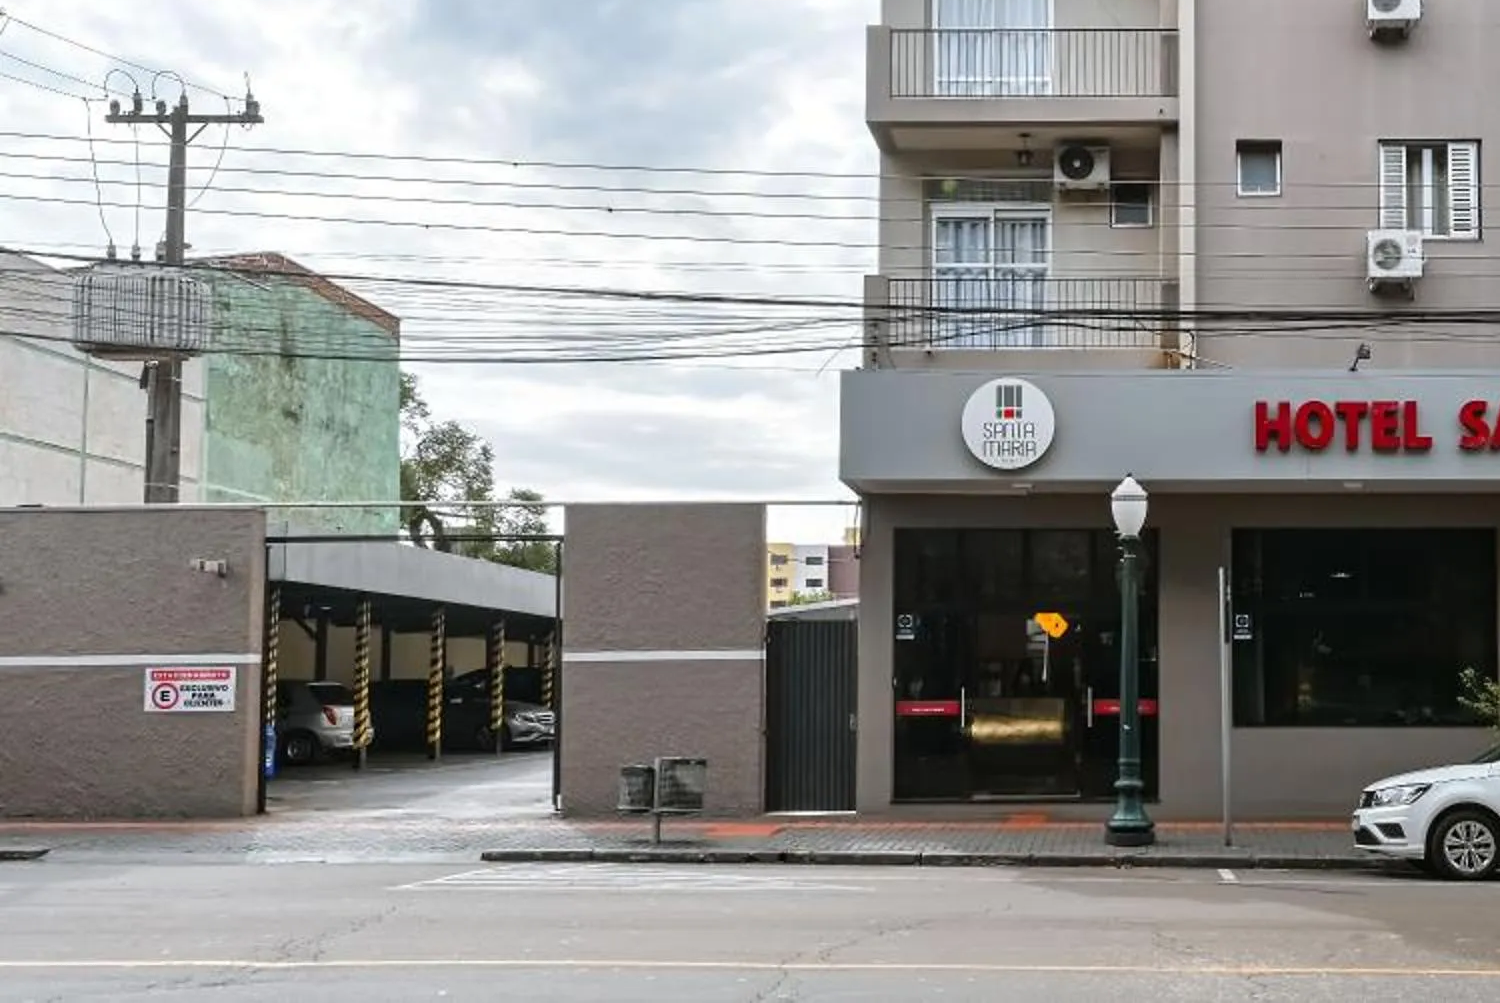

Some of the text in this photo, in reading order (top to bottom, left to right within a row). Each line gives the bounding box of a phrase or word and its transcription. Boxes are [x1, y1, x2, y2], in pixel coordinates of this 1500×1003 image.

[983, 421, 1036, 439] SANTA
[1254, 400, 1433, 453] HOTEL
[983, 440, 1037, 457] MARIA
[160, 690, 171, 702] E
